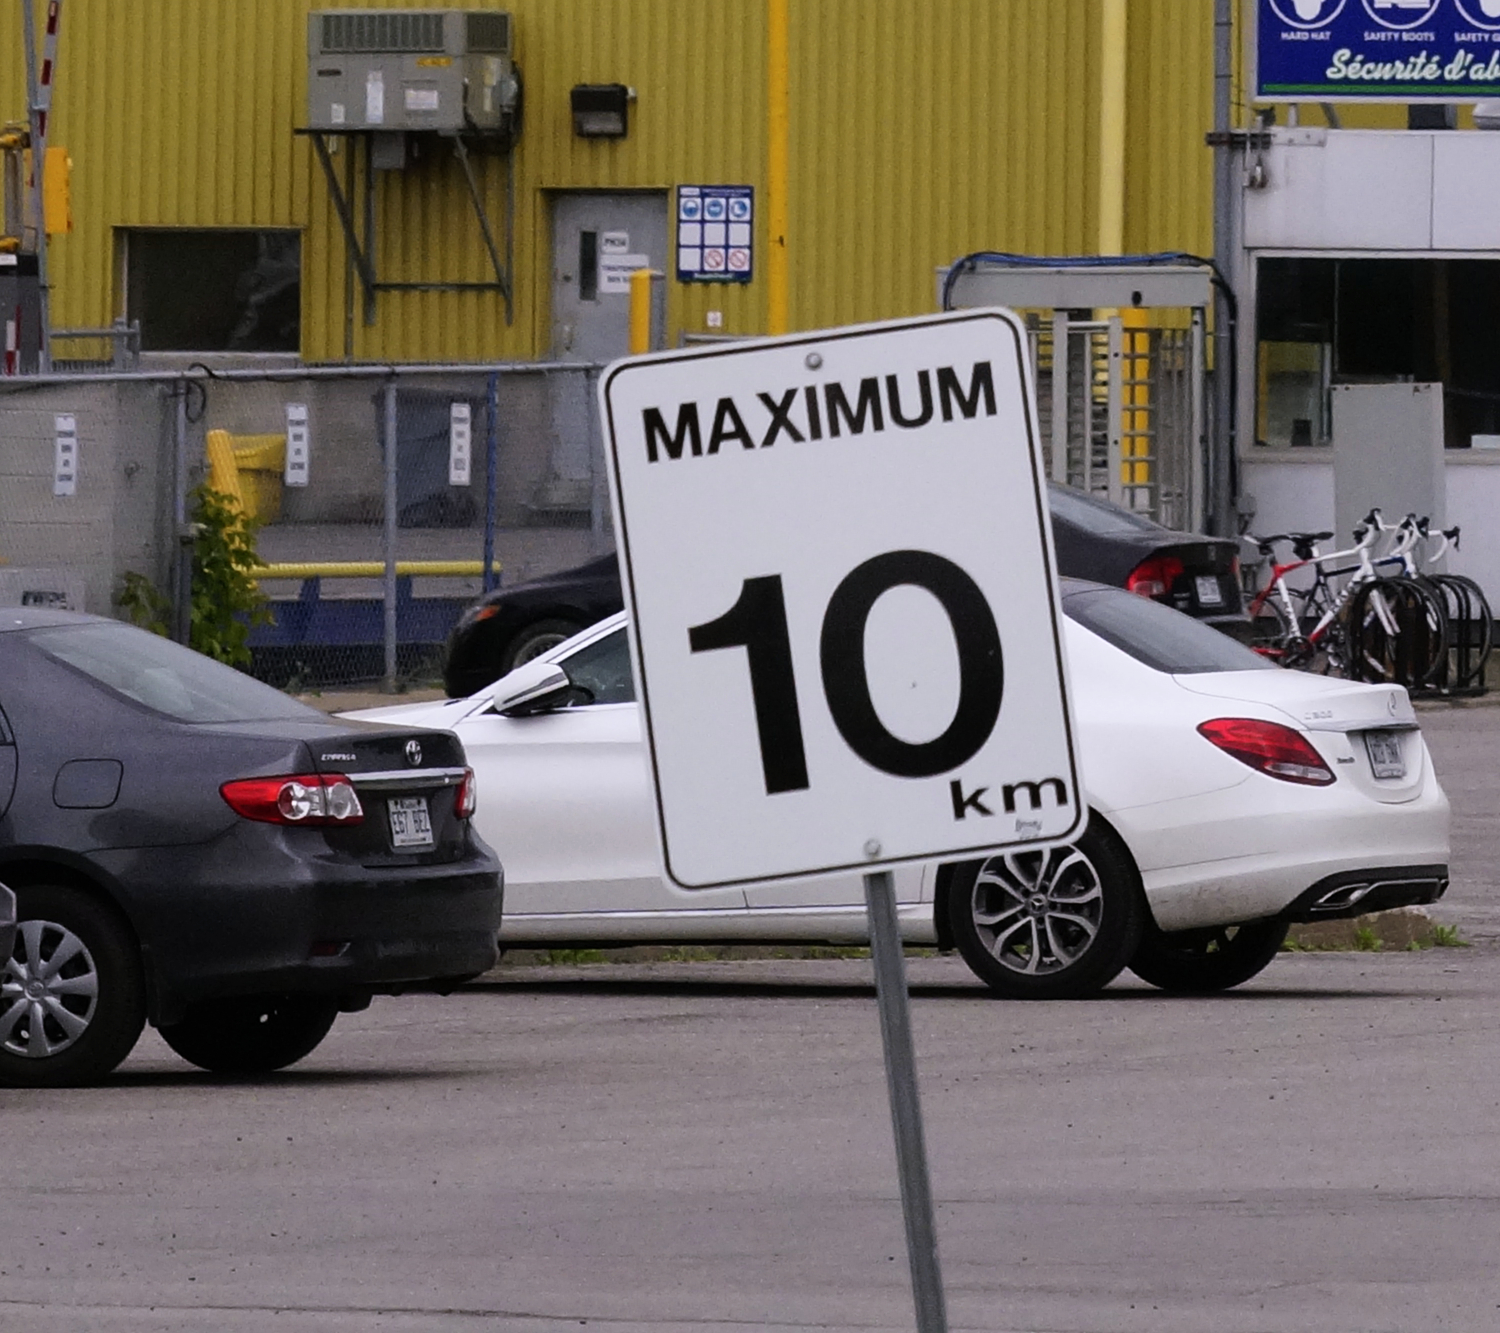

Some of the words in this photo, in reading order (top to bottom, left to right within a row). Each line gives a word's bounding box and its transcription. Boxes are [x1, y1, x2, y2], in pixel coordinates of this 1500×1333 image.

[1364, 32, 1399, 42] SAFETY
[1454, 32, 1489, 43] SAFETY
[1326, 48, 1441, 80] Sécurité
[641, 361, 998, 463] MAXIMUM
[687, 549, 1005, 795] 10
[949, 775, 1068, 820] km
